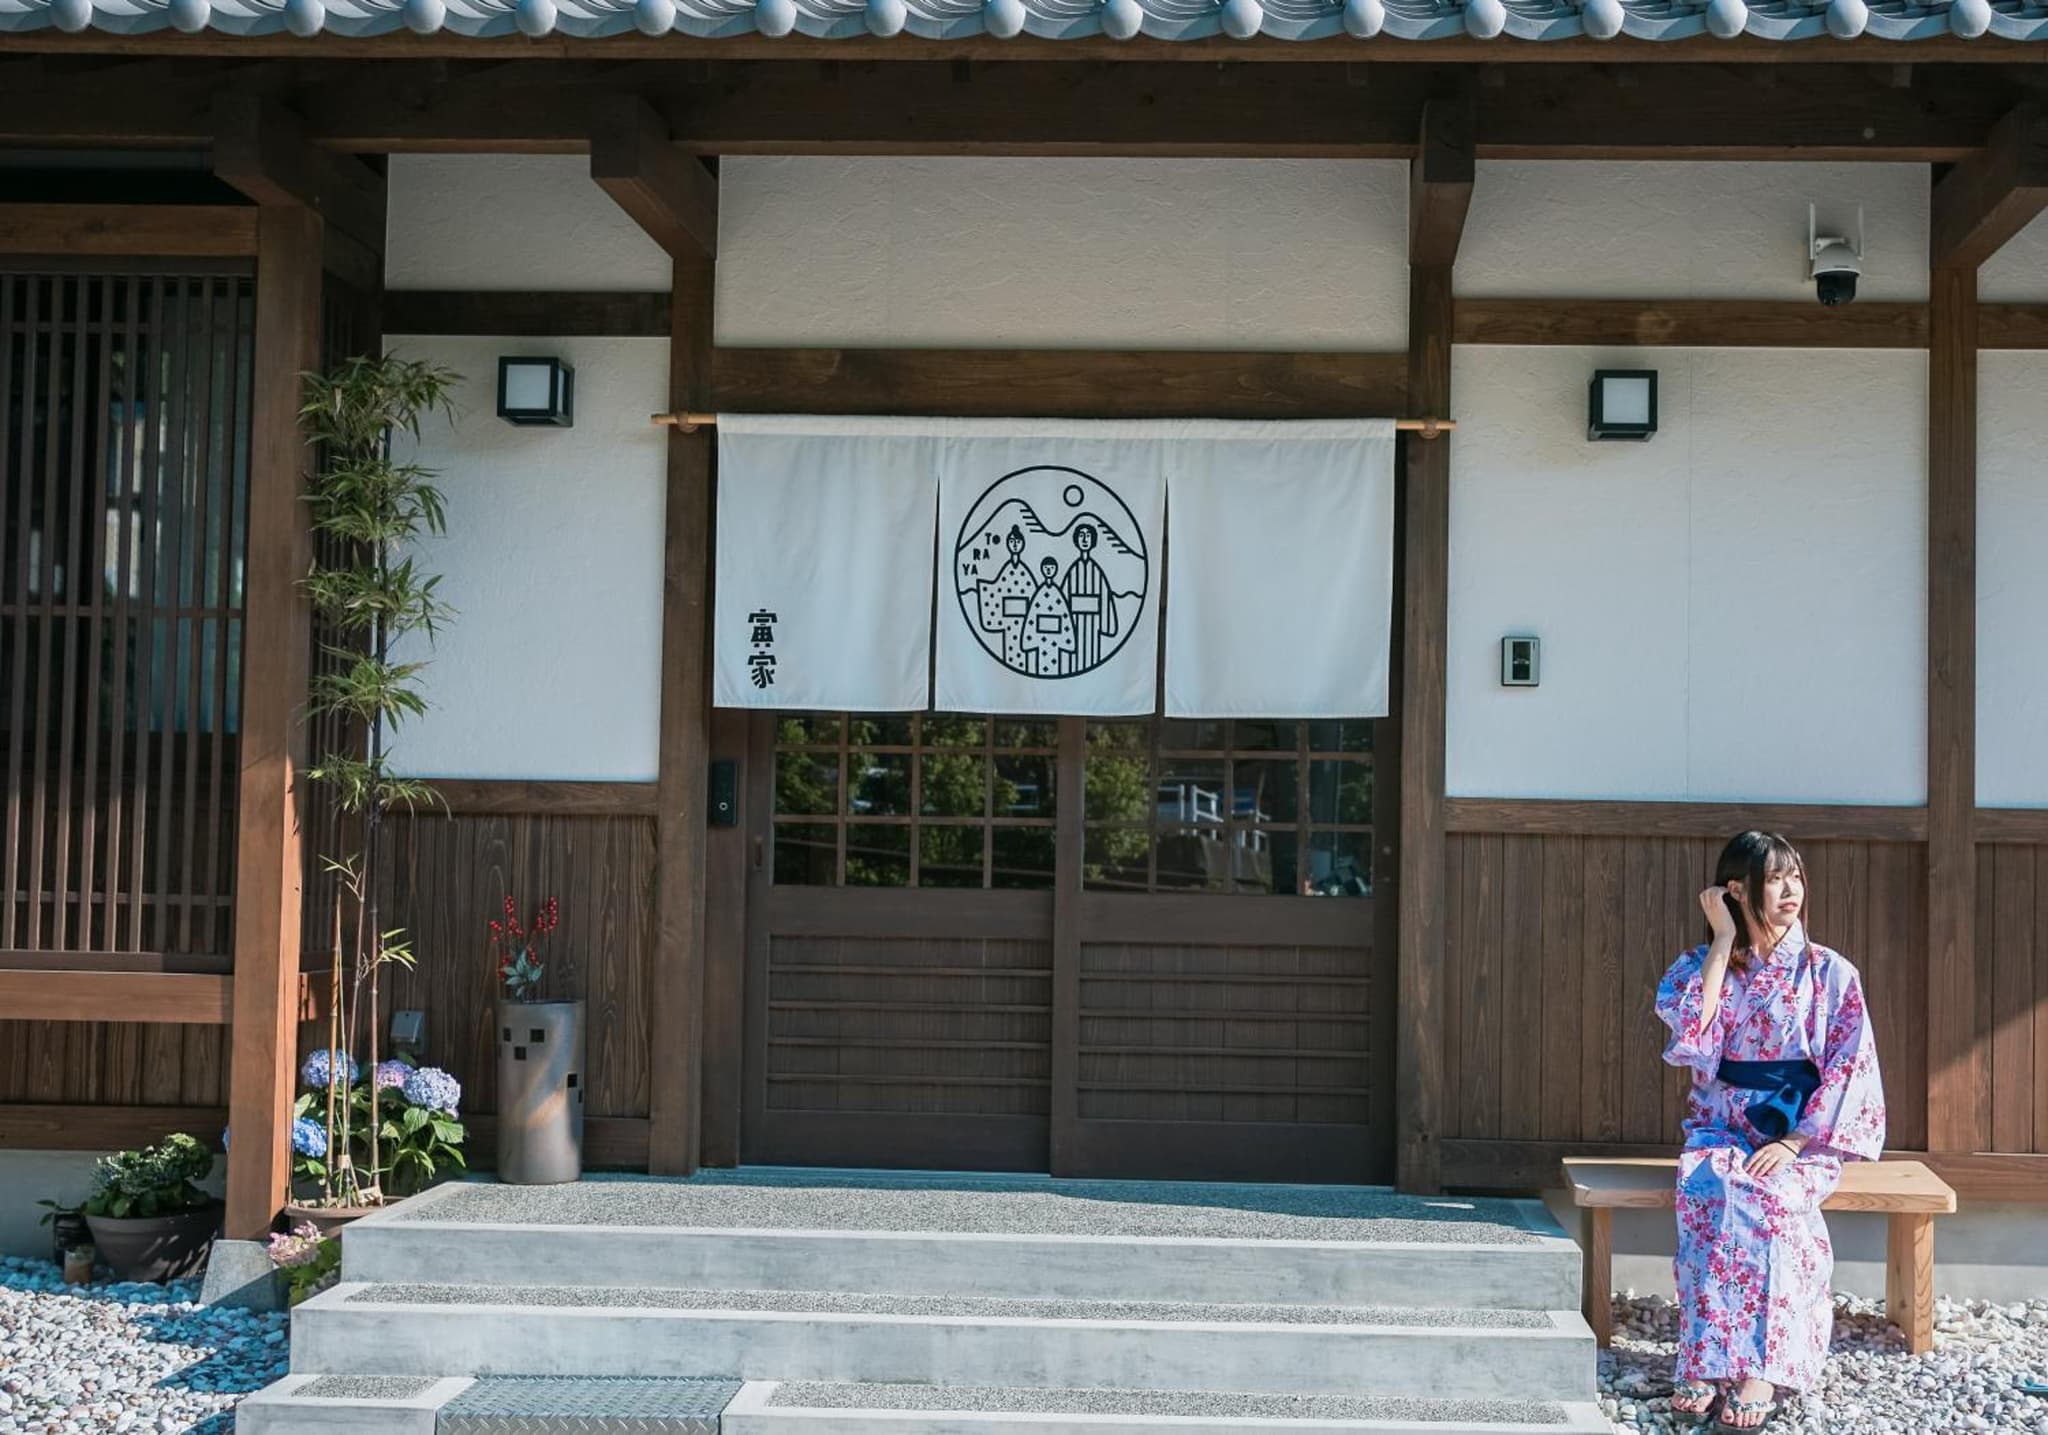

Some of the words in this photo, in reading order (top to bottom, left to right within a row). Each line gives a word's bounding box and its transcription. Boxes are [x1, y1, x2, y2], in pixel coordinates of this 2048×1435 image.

[985, 532, 1001, 545] TO
[972, 548, 990, 561] RA
[962, 563, 979, 576] YA
[747, 608, 778, 689] 寅家
